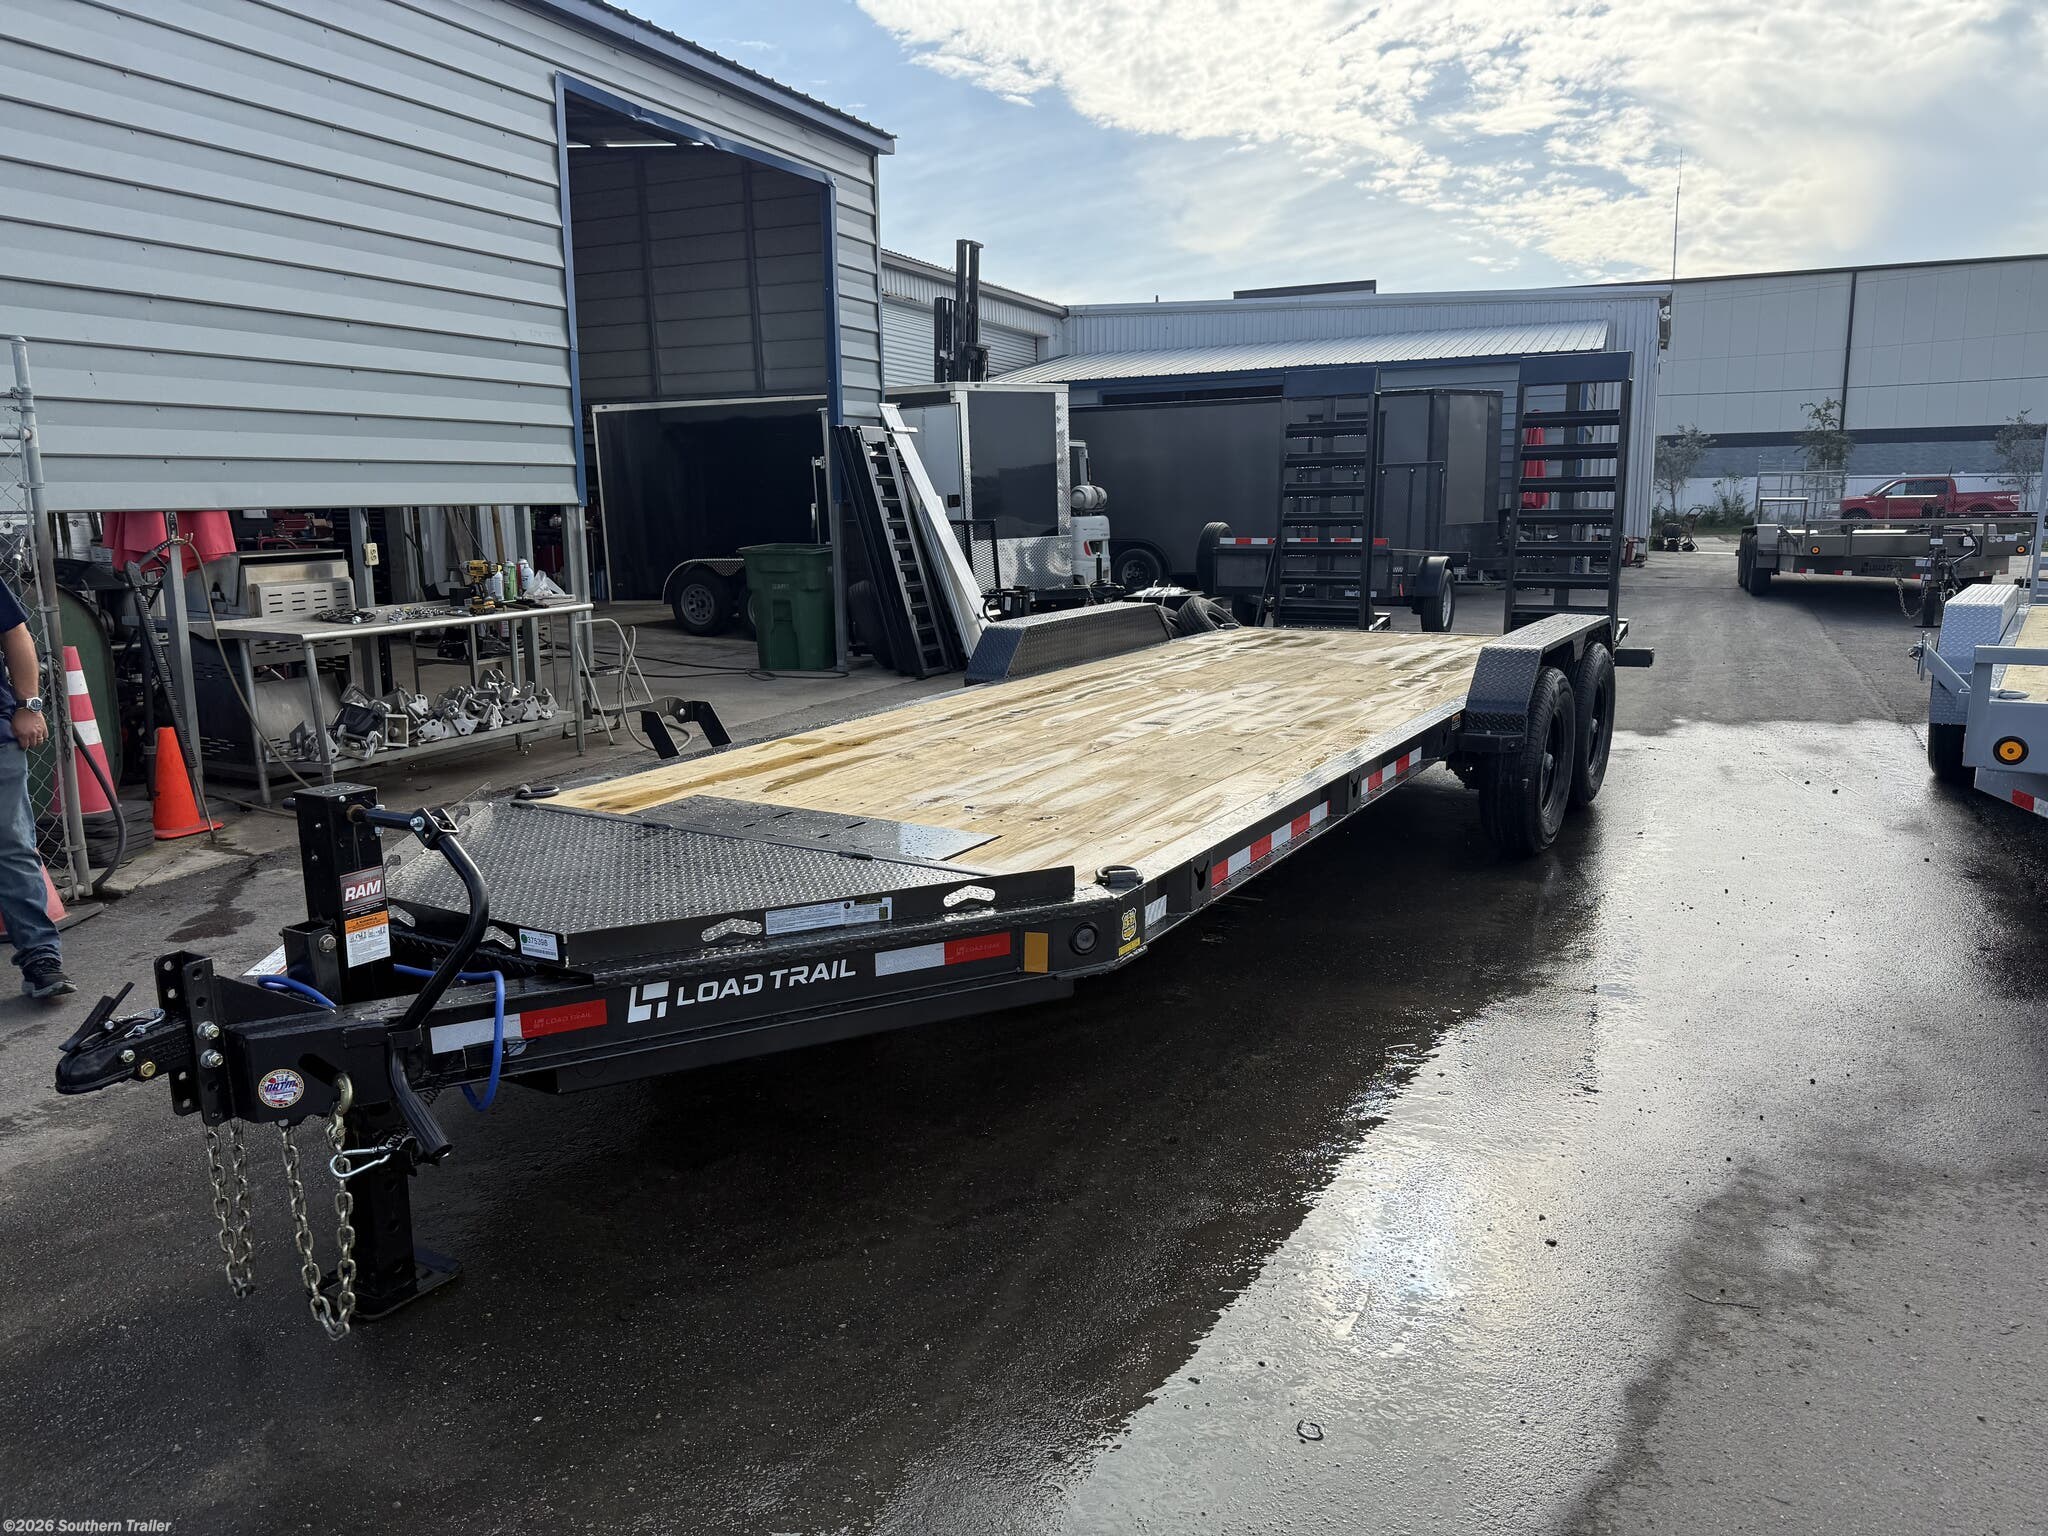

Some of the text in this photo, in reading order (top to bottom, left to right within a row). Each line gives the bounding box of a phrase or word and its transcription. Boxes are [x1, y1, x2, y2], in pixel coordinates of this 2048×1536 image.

[345, 880, 381, 902] RAM
[677, 973, 764, 1007] LOAD
[769, 959, 857, 989] TRAIL
[545, 1016, 568, 1025] LOAD
